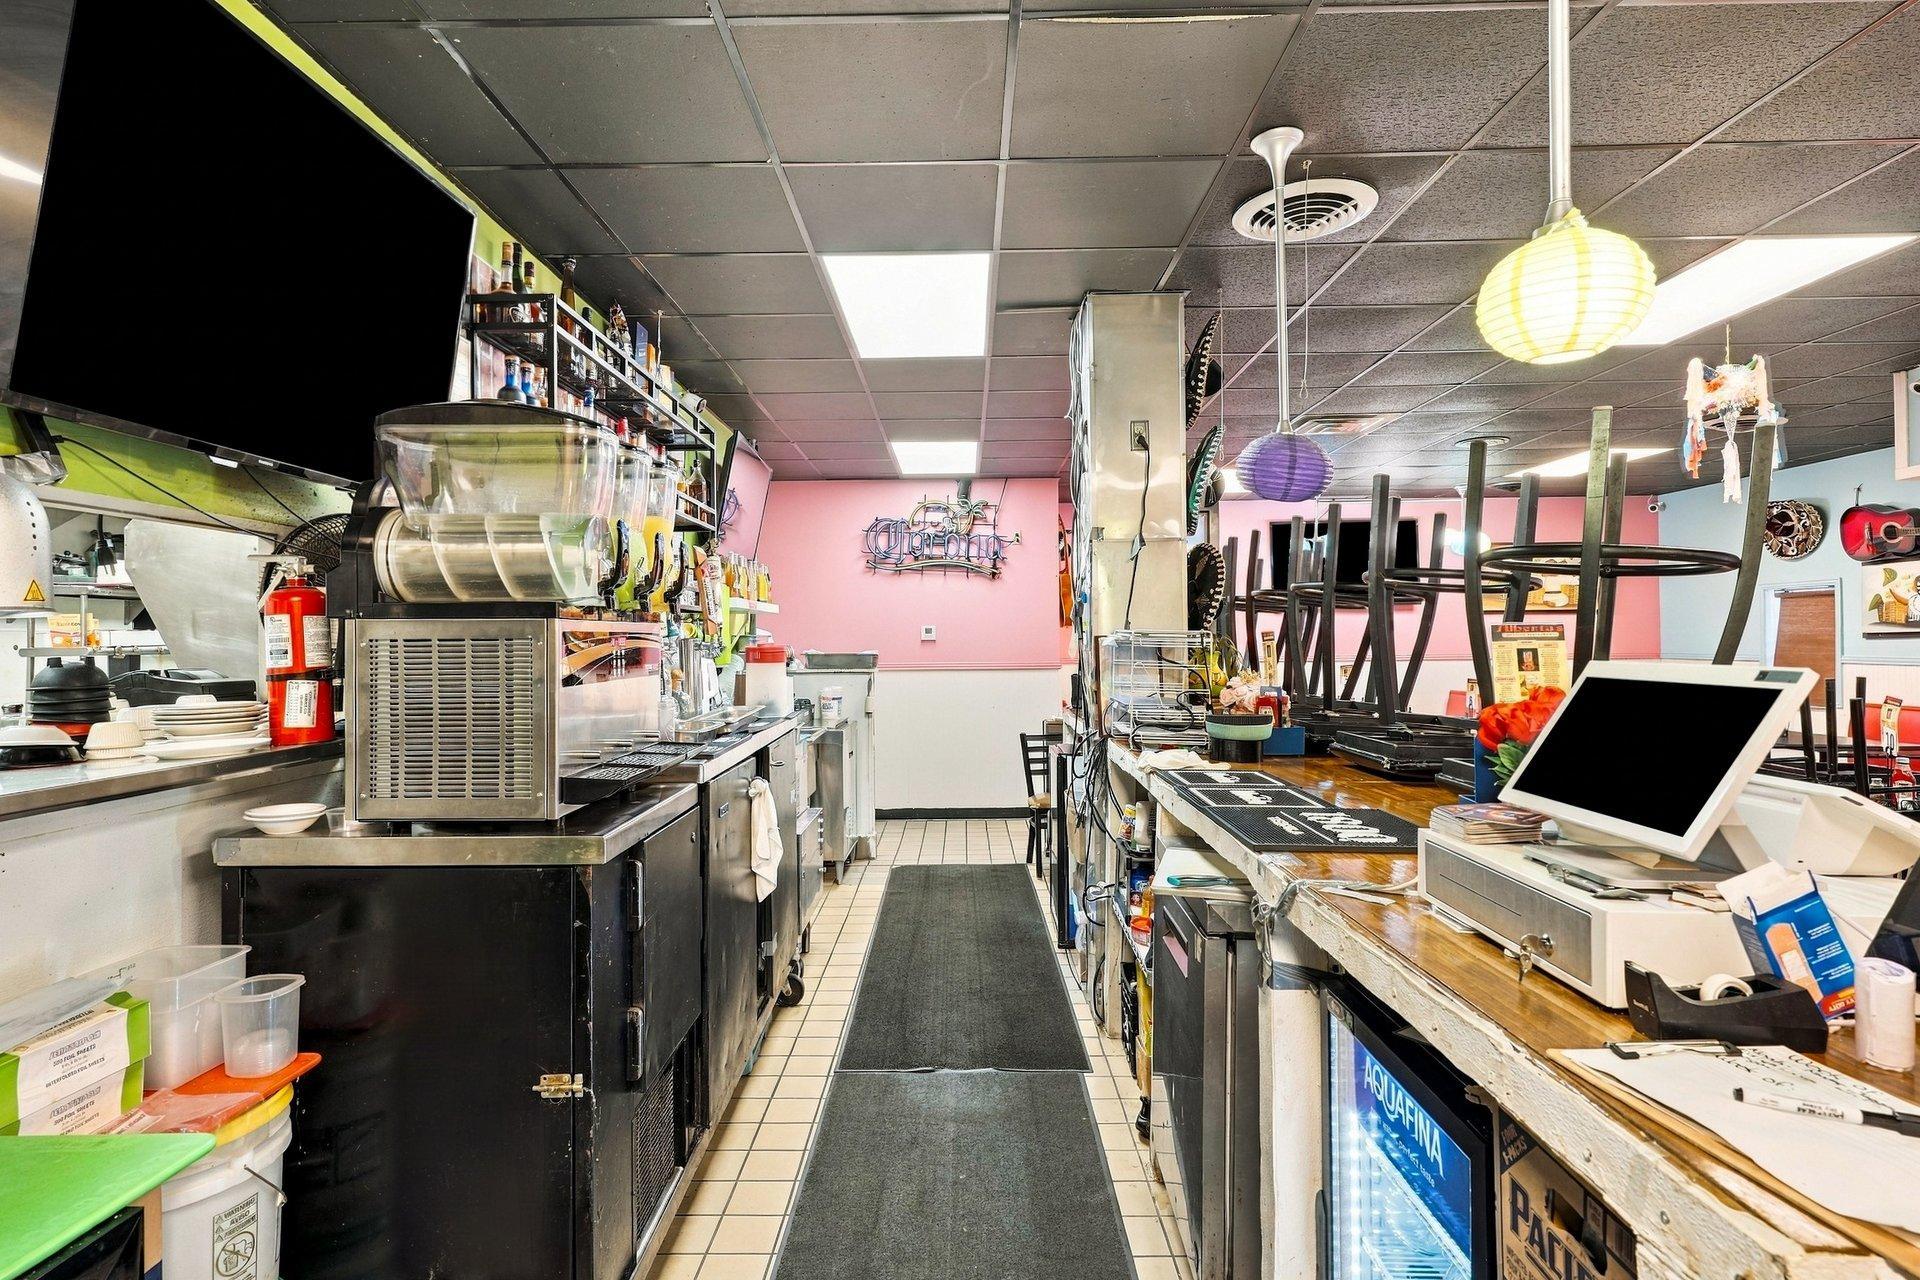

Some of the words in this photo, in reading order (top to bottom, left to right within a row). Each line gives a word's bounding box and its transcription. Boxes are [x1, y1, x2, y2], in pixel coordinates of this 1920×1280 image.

[866, 517, 1007, 564] Corona
[76, 1043, 97, 1056] SHEETS
[1363, 1054, 1445, 1181] AQUAFINA
